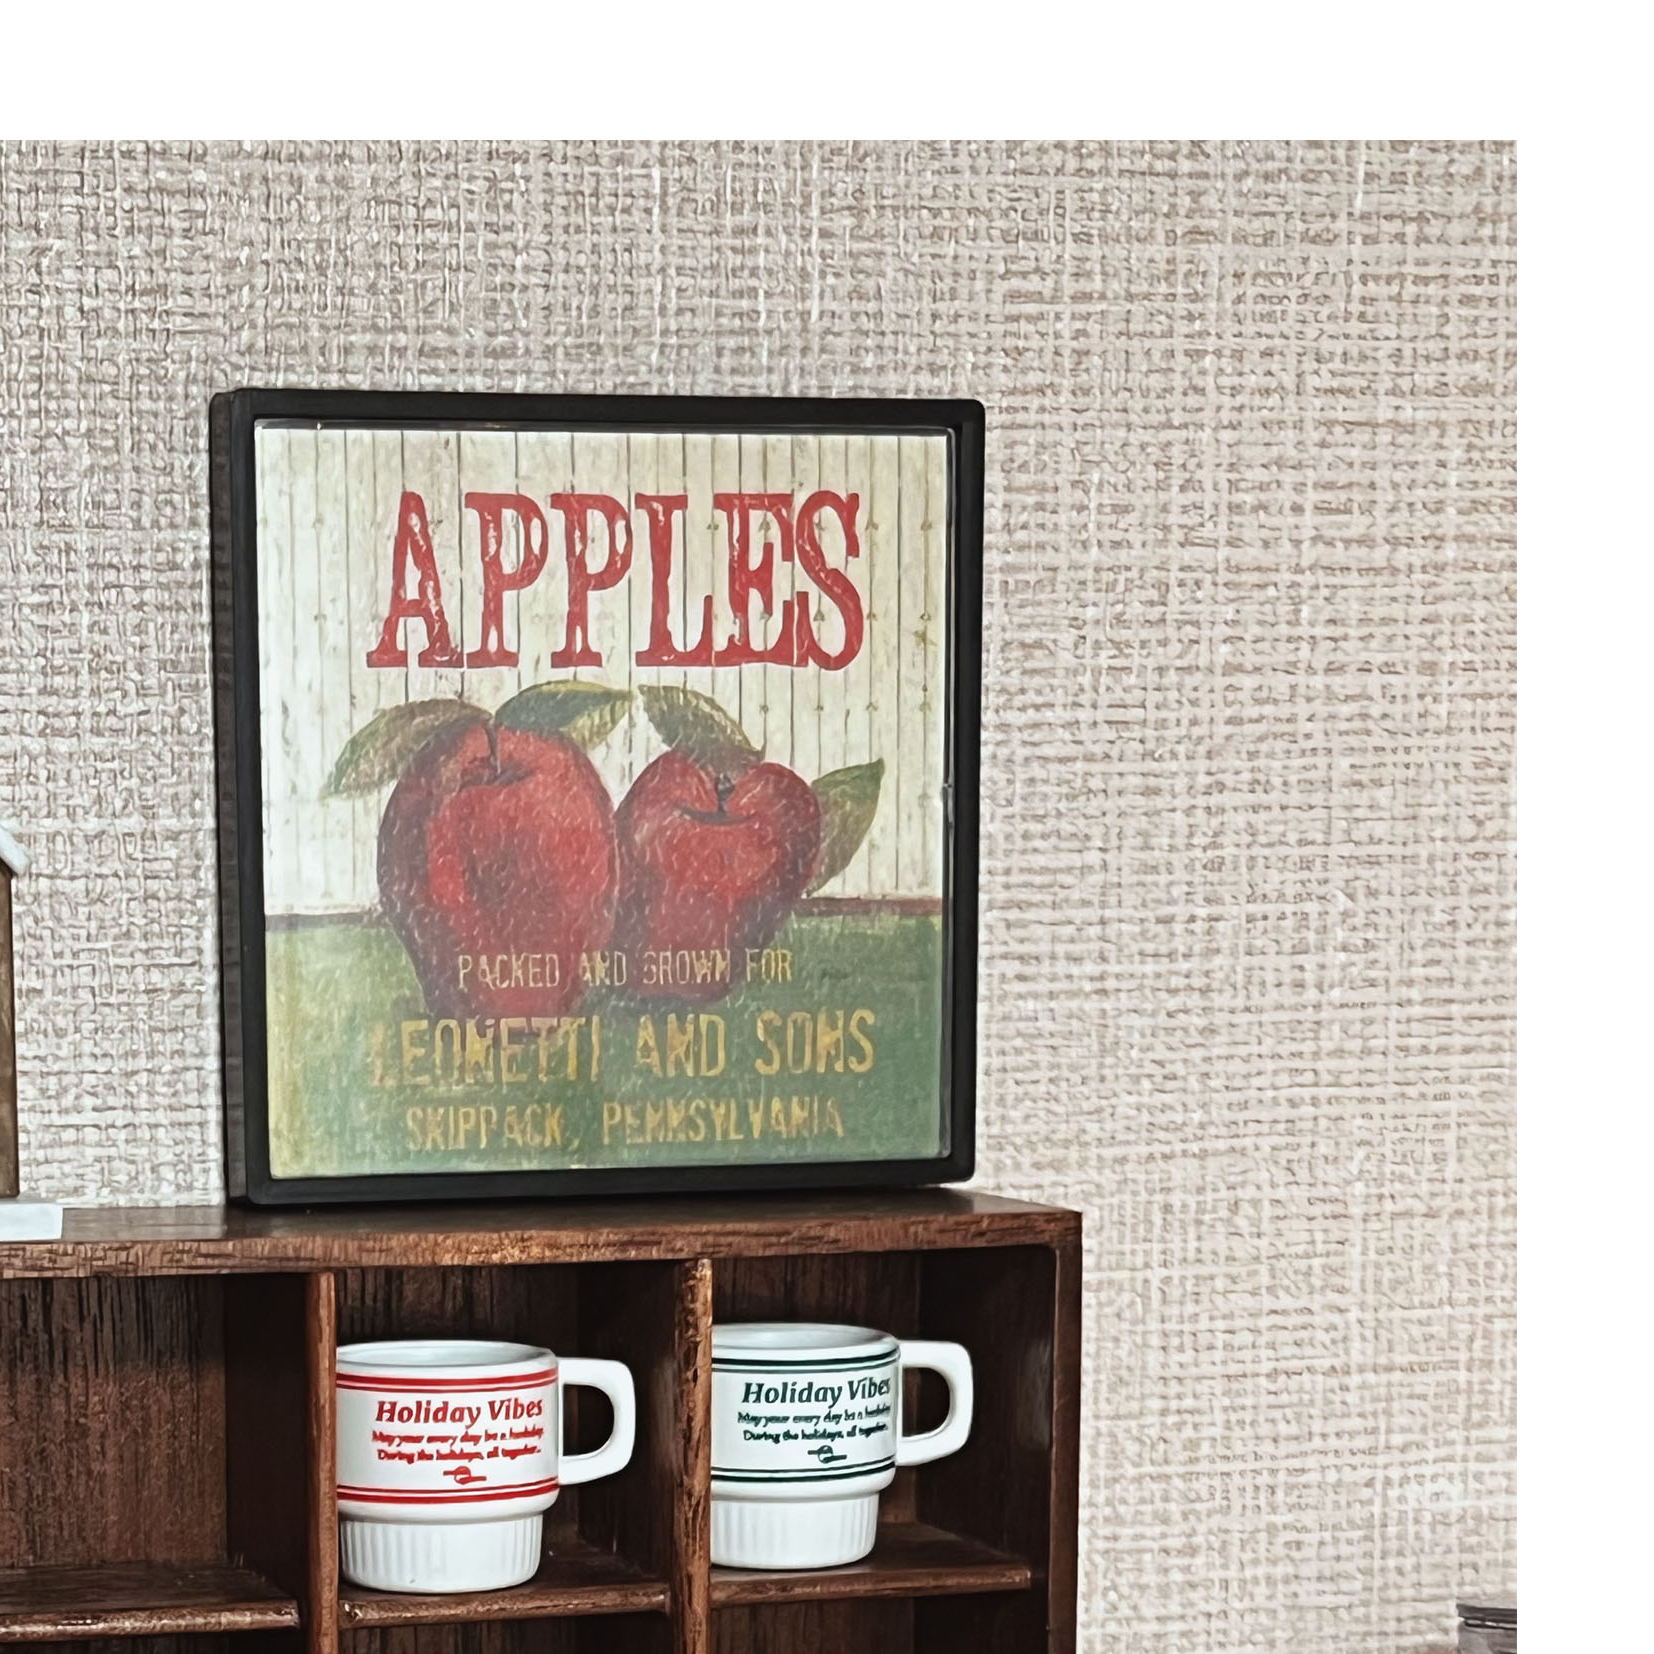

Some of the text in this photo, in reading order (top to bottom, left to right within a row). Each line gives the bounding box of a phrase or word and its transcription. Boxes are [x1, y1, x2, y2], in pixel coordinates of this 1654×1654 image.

[365, 490, 865, 671] APPLES
[458, 947, 794, 989] PACKED AND GROWN FOR
[368, 1008, 877, 1088] LEONETTI AND SONS
[602, 1097, 846, 1146] PENNSYLVANIA
[375, 1397, 544, 1430] Holiday Vibes
[741, 1376, 892, 1409] Holiday Vibes
